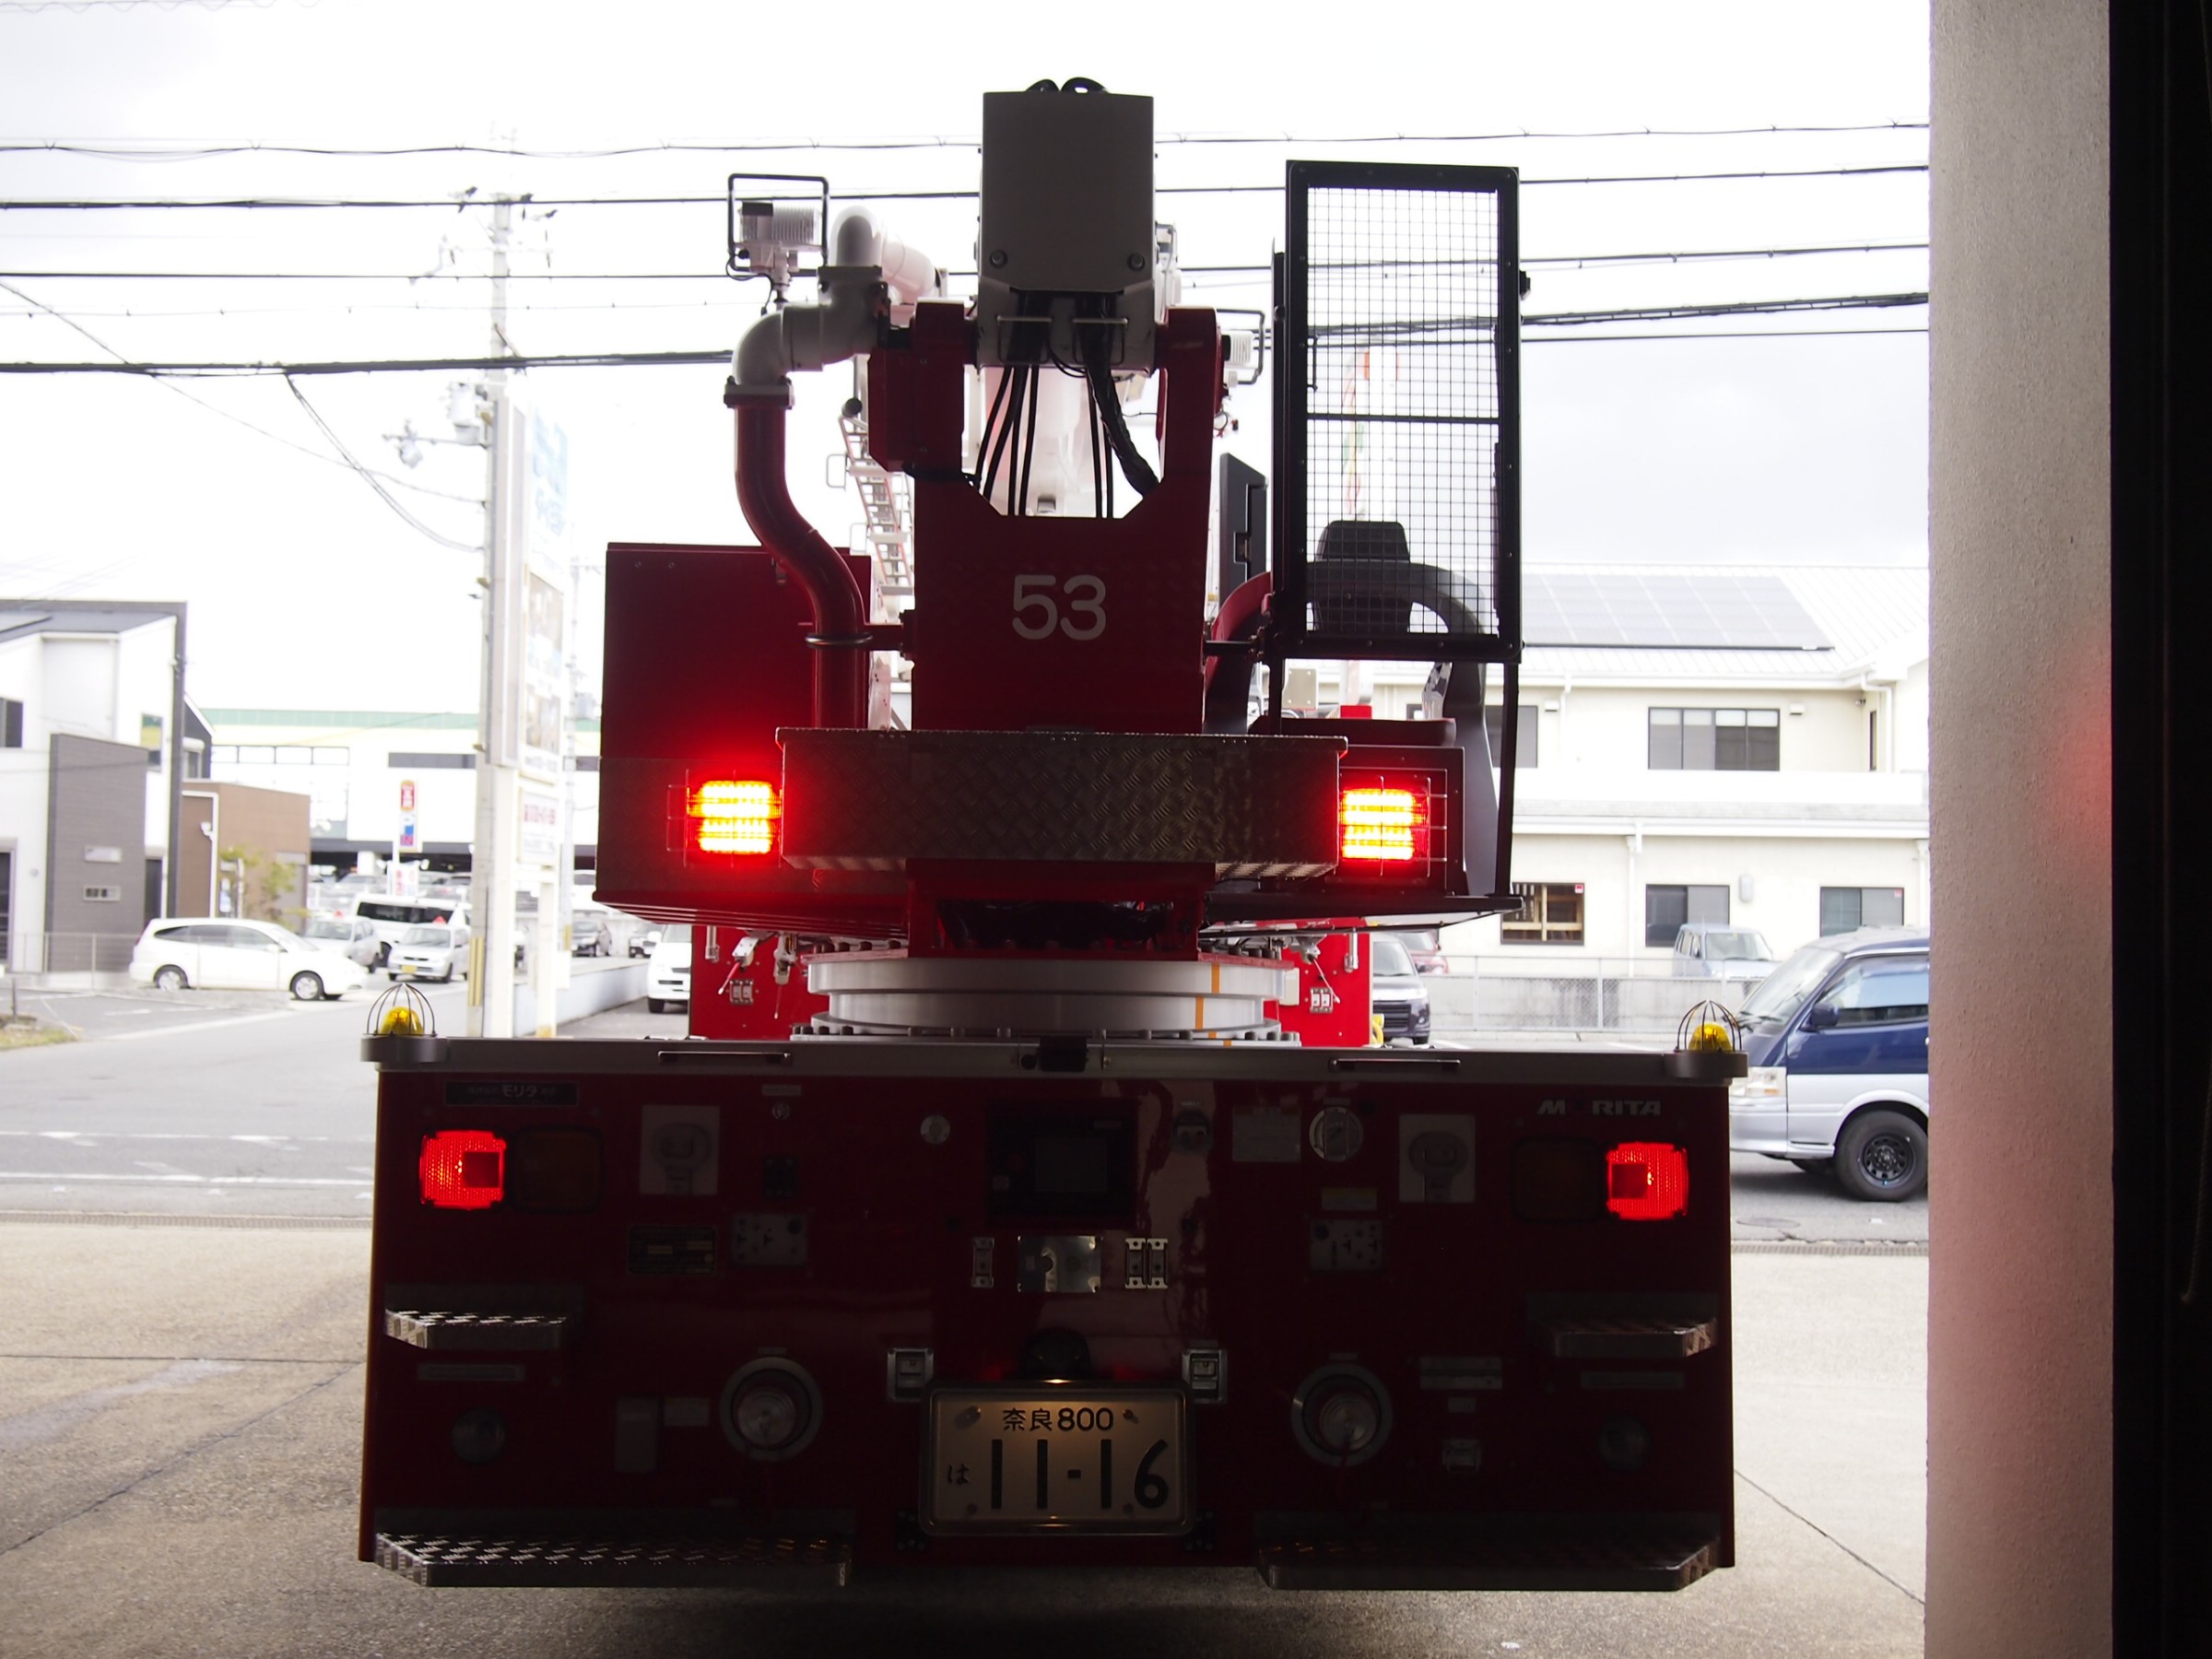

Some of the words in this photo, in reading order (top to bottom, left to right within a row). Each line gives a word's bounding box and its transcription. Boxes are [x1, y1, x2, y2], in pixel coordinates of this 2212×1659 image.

[1012, 574, 1106, 640] 53
[1535, 1099, 1662, 1116] MRITA
[947, 1464, 970, 1485] は
[991, 1439, 1169, 1509] 11-16
